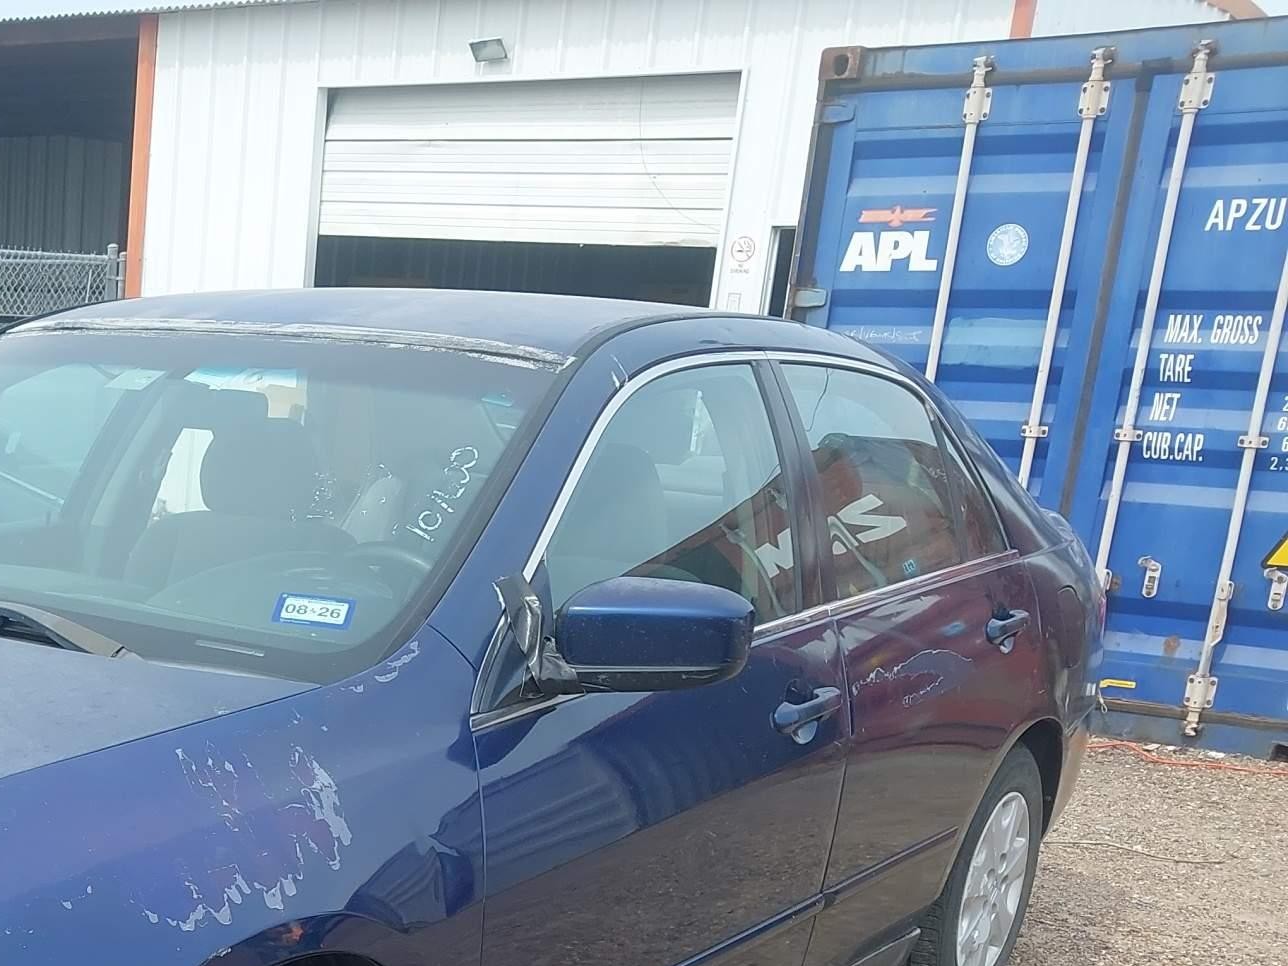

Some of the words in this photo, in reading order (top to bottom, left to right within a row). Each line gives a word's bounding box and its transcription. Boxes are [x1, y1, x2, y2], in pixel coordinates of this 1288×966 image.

[1204, 197, 1288, 232] APZU
[839, 230, 938, 272] APL
[1164, 314, 1204, 344] MAX.
[1210, 314, 1262, 345] GROSS
[1159, 353, 1194, 383] TARE
[1149, 392, 1181, 422] NET
[1142, 431, 1205, 462] CUB.CAP.
